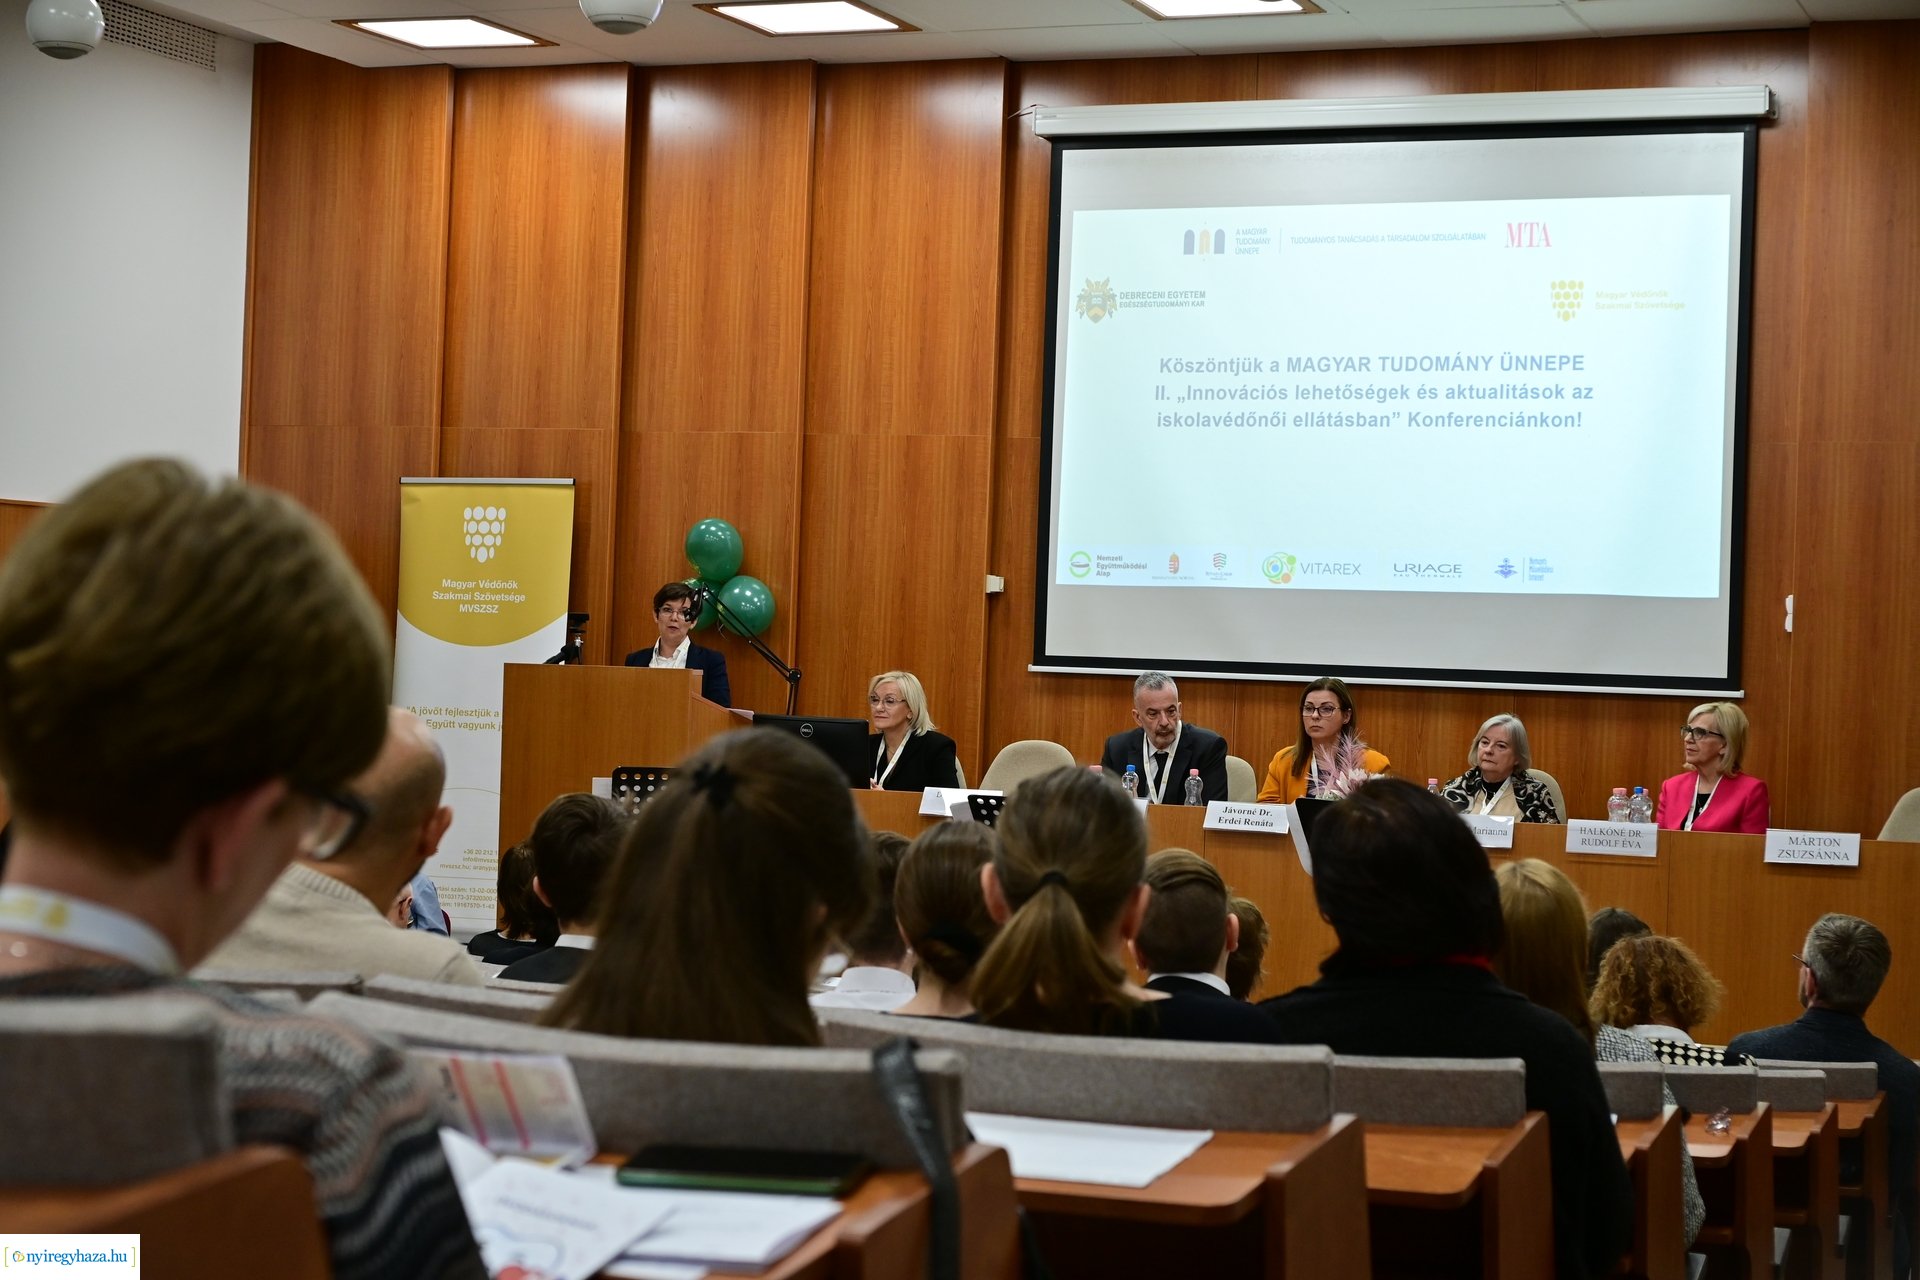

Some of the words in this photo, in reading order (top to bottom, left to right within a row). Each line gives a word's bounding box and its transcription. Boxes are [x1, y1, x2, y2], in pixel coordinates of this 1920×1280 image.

[1241, 228, 1267, 236] MAGYAR
[1504, 221, 1552, 248] MTA
[1235, 236, 1271, 246] TUDOMÁNY
[1290, 235, 1336, 245] TUDOMÁNYOS
[1432, 231, 1487, 242] SZOLGÁLATÁBAN
[1119, 291, 1166, 300] DEBRECENI
[1167, 290, 1206, 299] EGYETEM
[1595, 290, 1628, 301] Magyar
[1119, 300, 1190, 309] EGÉSZSÉGTUDOMÁNYI
[1191, 300, 1205, 308] KAR
[1595, 301, 1633, 310] Szakmai
[1634, 300, 1686, 311] Szövetsége
[1159, 356, 1263, 376] Köszöntjük
[1269, 359, 1281, 373] a
[1286, 356, 1372, 373] MAGYAR
[1378, 352, 1493, 373] TUDOMÁNY
[1500, 352, 1585, 371] ÜNNEPE
[1155, 384, 1171, 400] II.
[1177, 384, 1288, 404] „Innovációs
[1295, 384, 1410, 404] lehetőségek
[1416, 384, 1439, 400] és
[1445, 383, 1565, 400] aktualitások
[1572, 387, 1594, 400] az
[1157, 411, 1287, 428] iskolavédőnői
[1407, 411, 1582, 428] Konferenciánkon!
[1096, 554, 1123, 562] Nemzeti
[1096, 570, 1111, 578] Alap
[1300, 562, 1362, 576] VITAREX
[442, 579, 477, 589] Magyar
[479, 578, 518, 589] Védőnők
[432, 591, 472, 601] Szakmai
[474, 591, 526, 603] Szövetsége
[459, 604, 499, 614] MVSZSZ
[419, 706, 443, 716] jövőt
[445, 707, 492, 718] fejlesztjük
[493, 710, 500, 718] a
[426, 719, 456, 729] Együtt
[458, 721, 497, 731] vagyunk
[1222, 806, 1257, 816] Jávorné
[1259, 808, 1273, 817] Dr.
[1218, 816, 1242, 825] Erdei
[1243, 818, 1274, 828] Renáta
[1628, 829, 1644, 838] DR.
[1581, 838, 1620, 848] RUDOLF
[1622, 838, 1642, 849] ÉVA
[1788, 835, 1841, 847] MÁRTON
[1777, 848, 1850, 861] ZSUZSÁNNA
